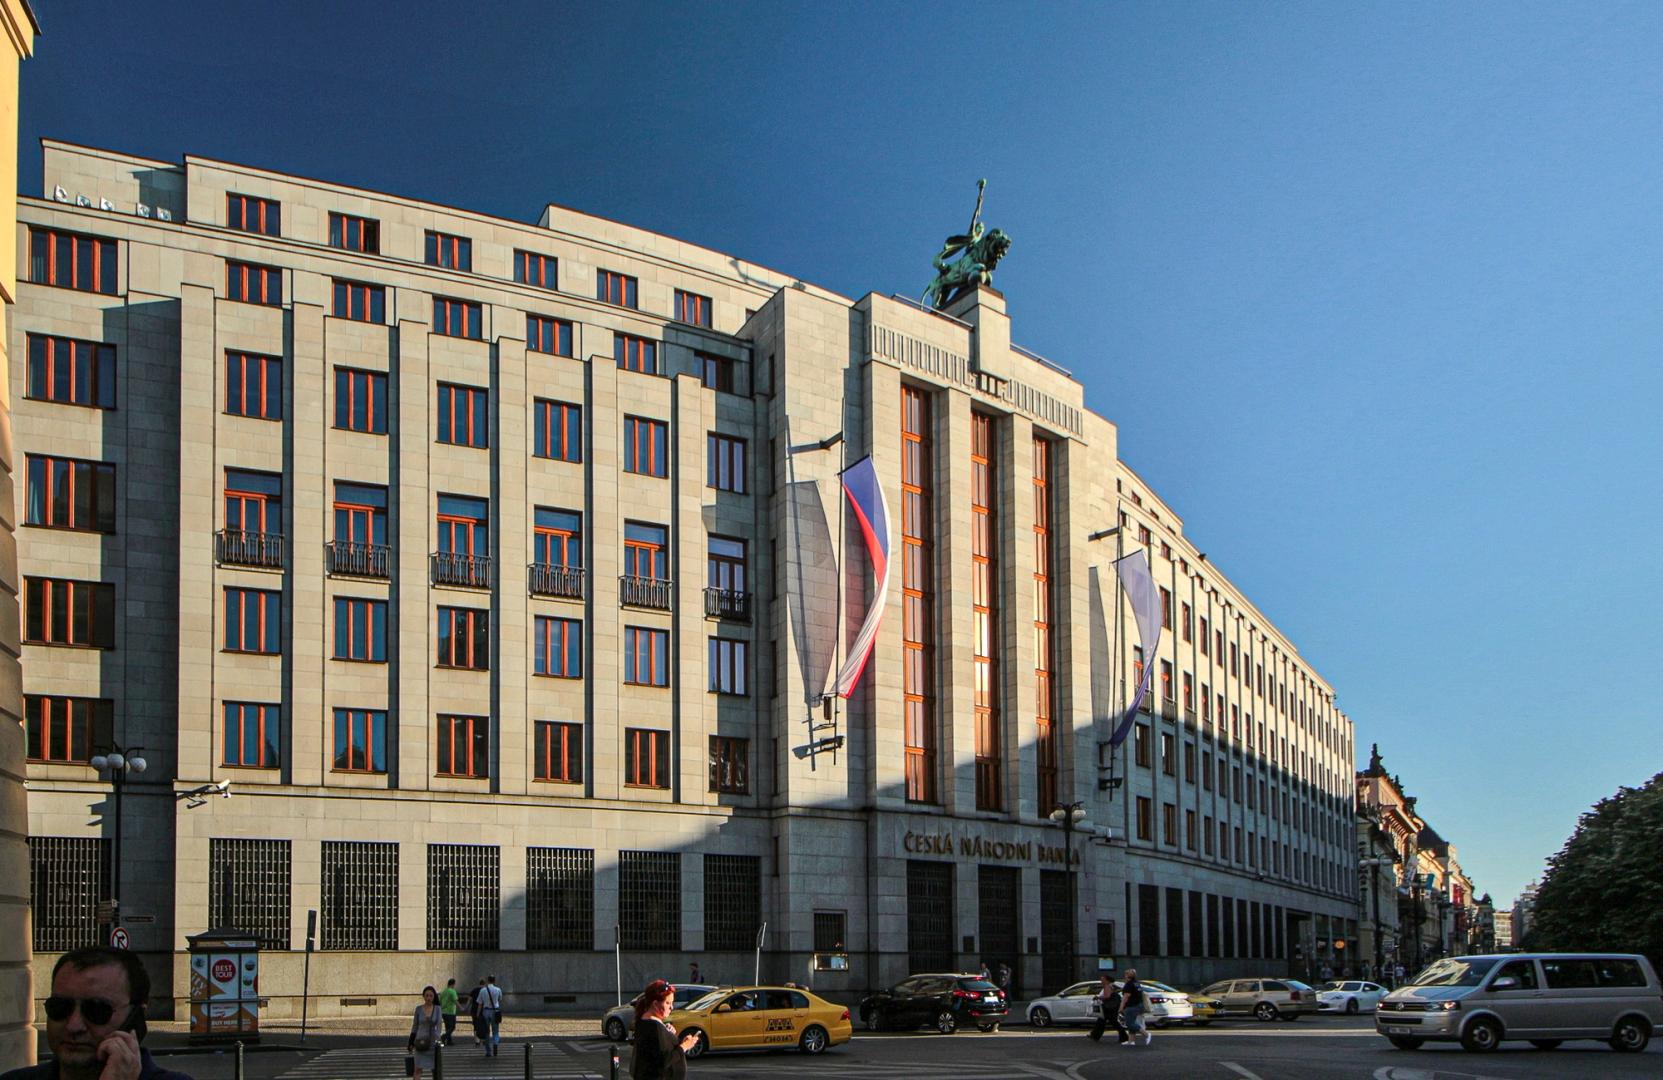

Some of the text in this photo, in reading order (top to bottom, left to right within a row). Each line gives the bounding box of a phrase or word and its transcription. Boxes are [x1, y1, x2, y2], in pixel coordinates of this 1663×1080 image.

[904, 830, 1080, 865] ČESKÁ NÁRODNÍ BANA
